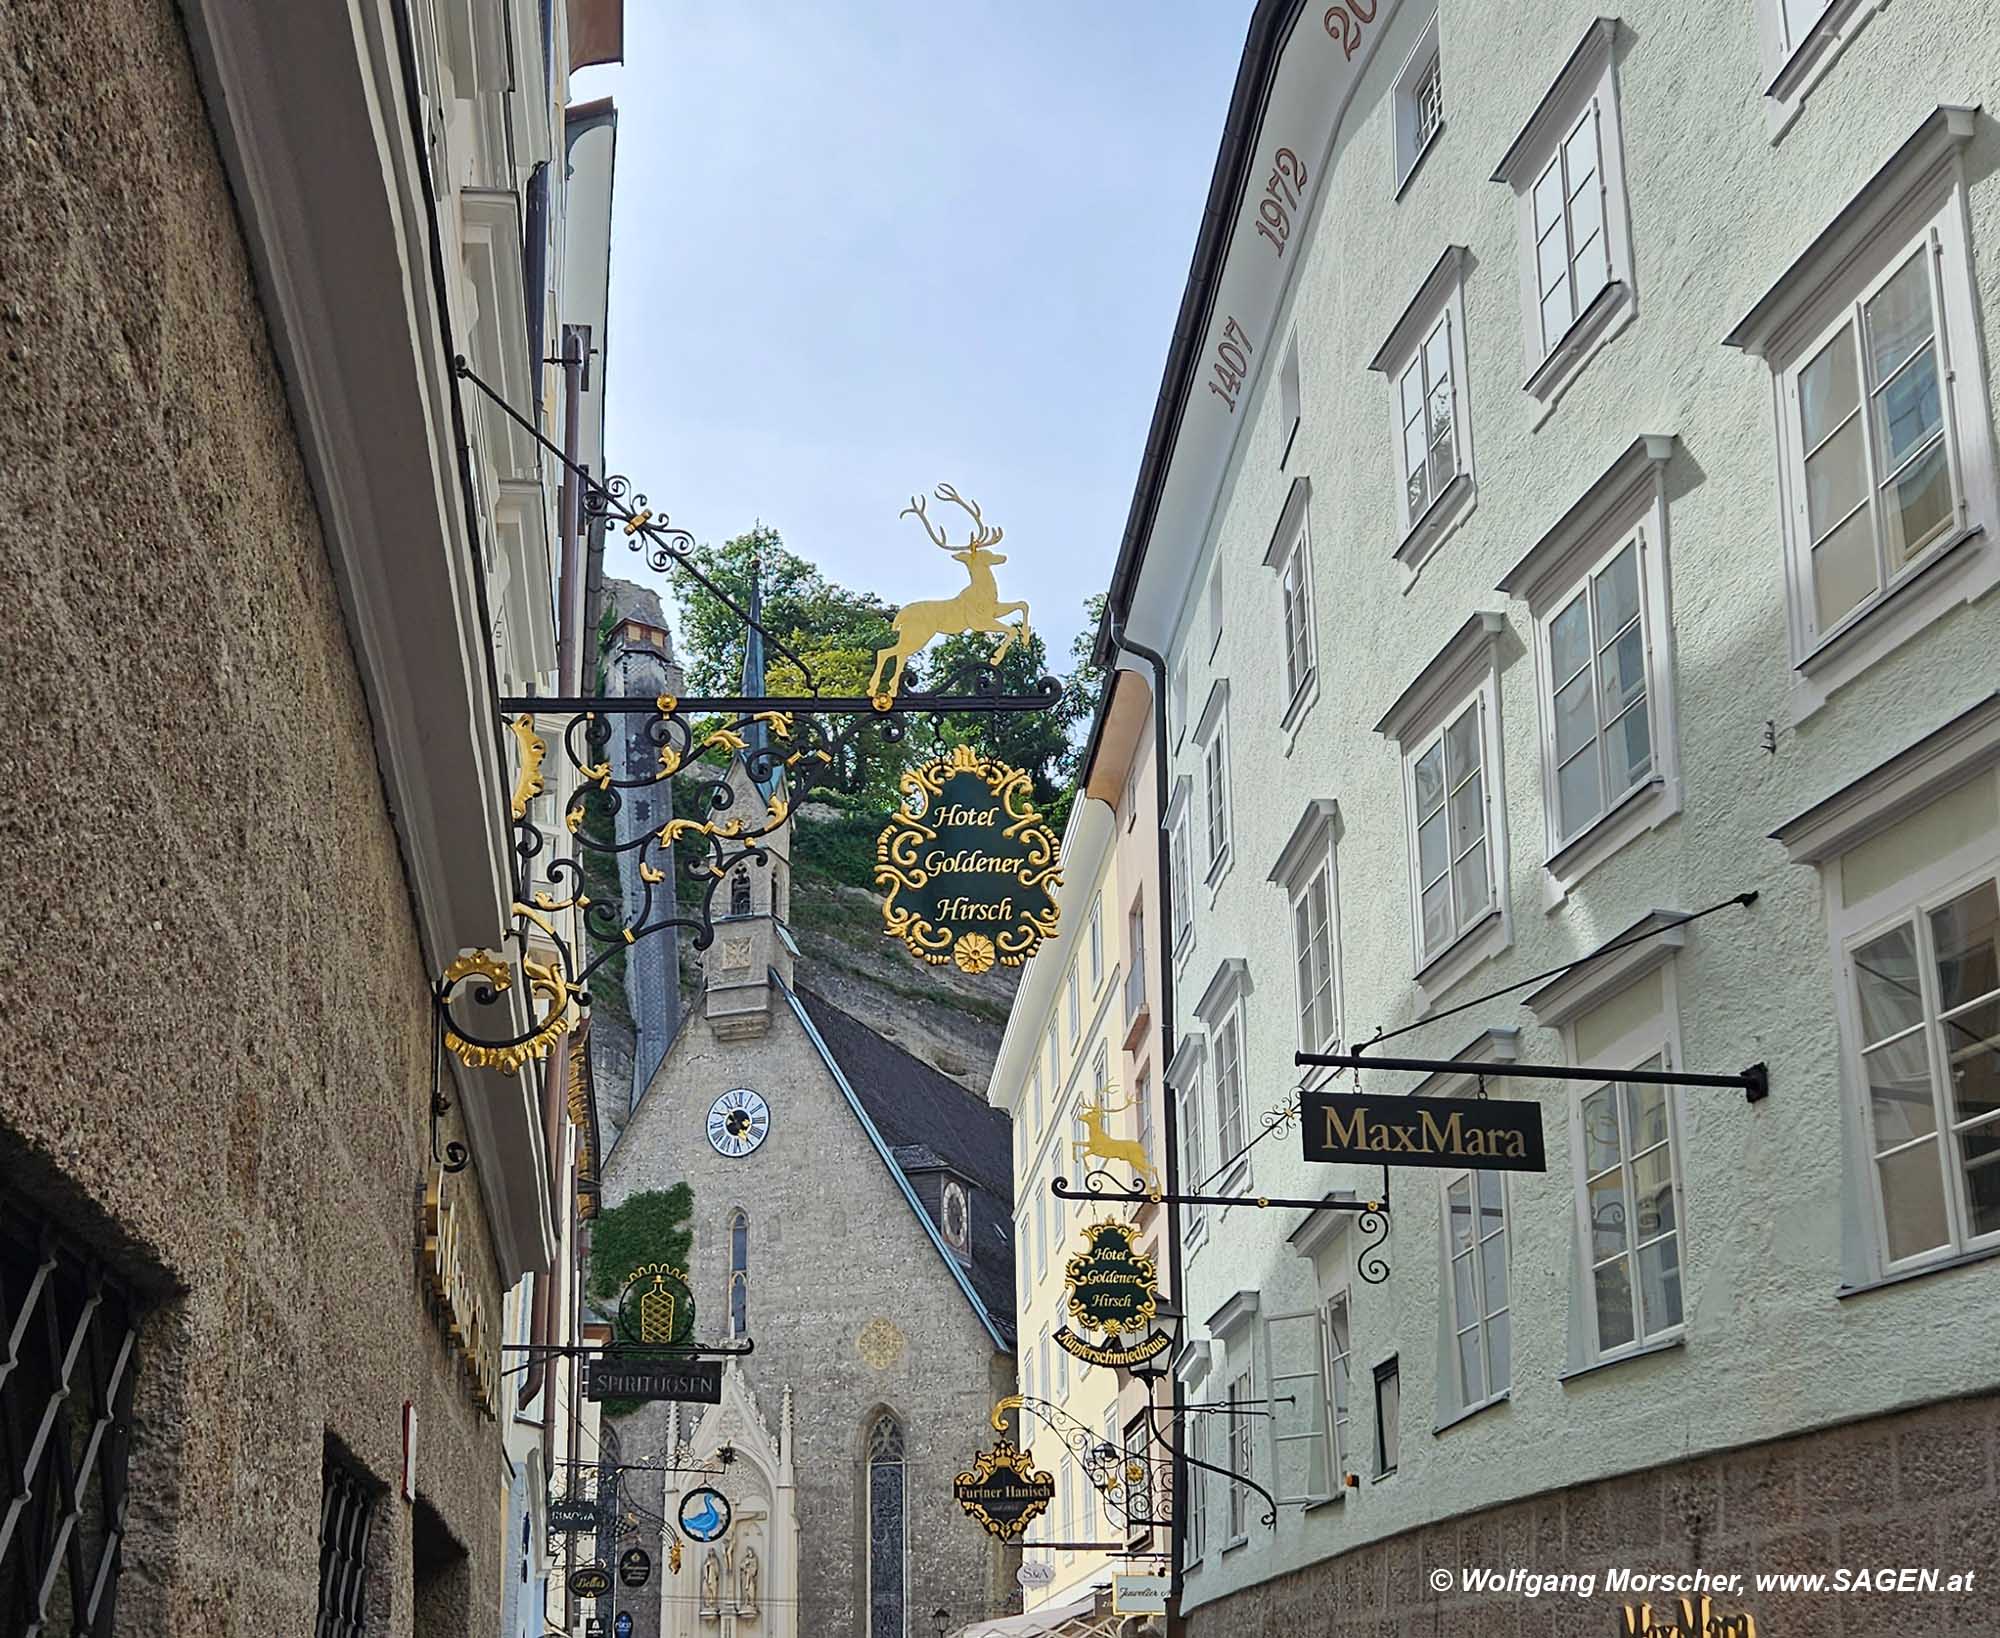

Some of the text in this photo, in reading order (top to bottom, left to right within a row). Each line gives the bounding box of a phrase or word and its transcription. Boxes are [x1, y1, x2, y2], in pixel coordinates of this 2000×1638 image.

[1256, 148, 1308, 258] 1972
[1208, 315, 1253, 413] 1407
[932, 803, 1000, 828] Hotel
[924, 850, 1025, 877] Goldener
[935, 897, 1013, 922] Hirsch
[1320, 1106, 1527, 1158] MaxMara
[1094, 1247, 1129, 1261] Hotel
[1087, 1269, 1138, 1285] Goldener
[1091, 1293, 1132, 1308] Hirsch
[1057, 1328, 1168, 1365] Kupferschmiedhaus
[596, 1374, 713, 1393] SPIRITUOSEN
[1005, 1484, 1051, 1499] Hanisch
